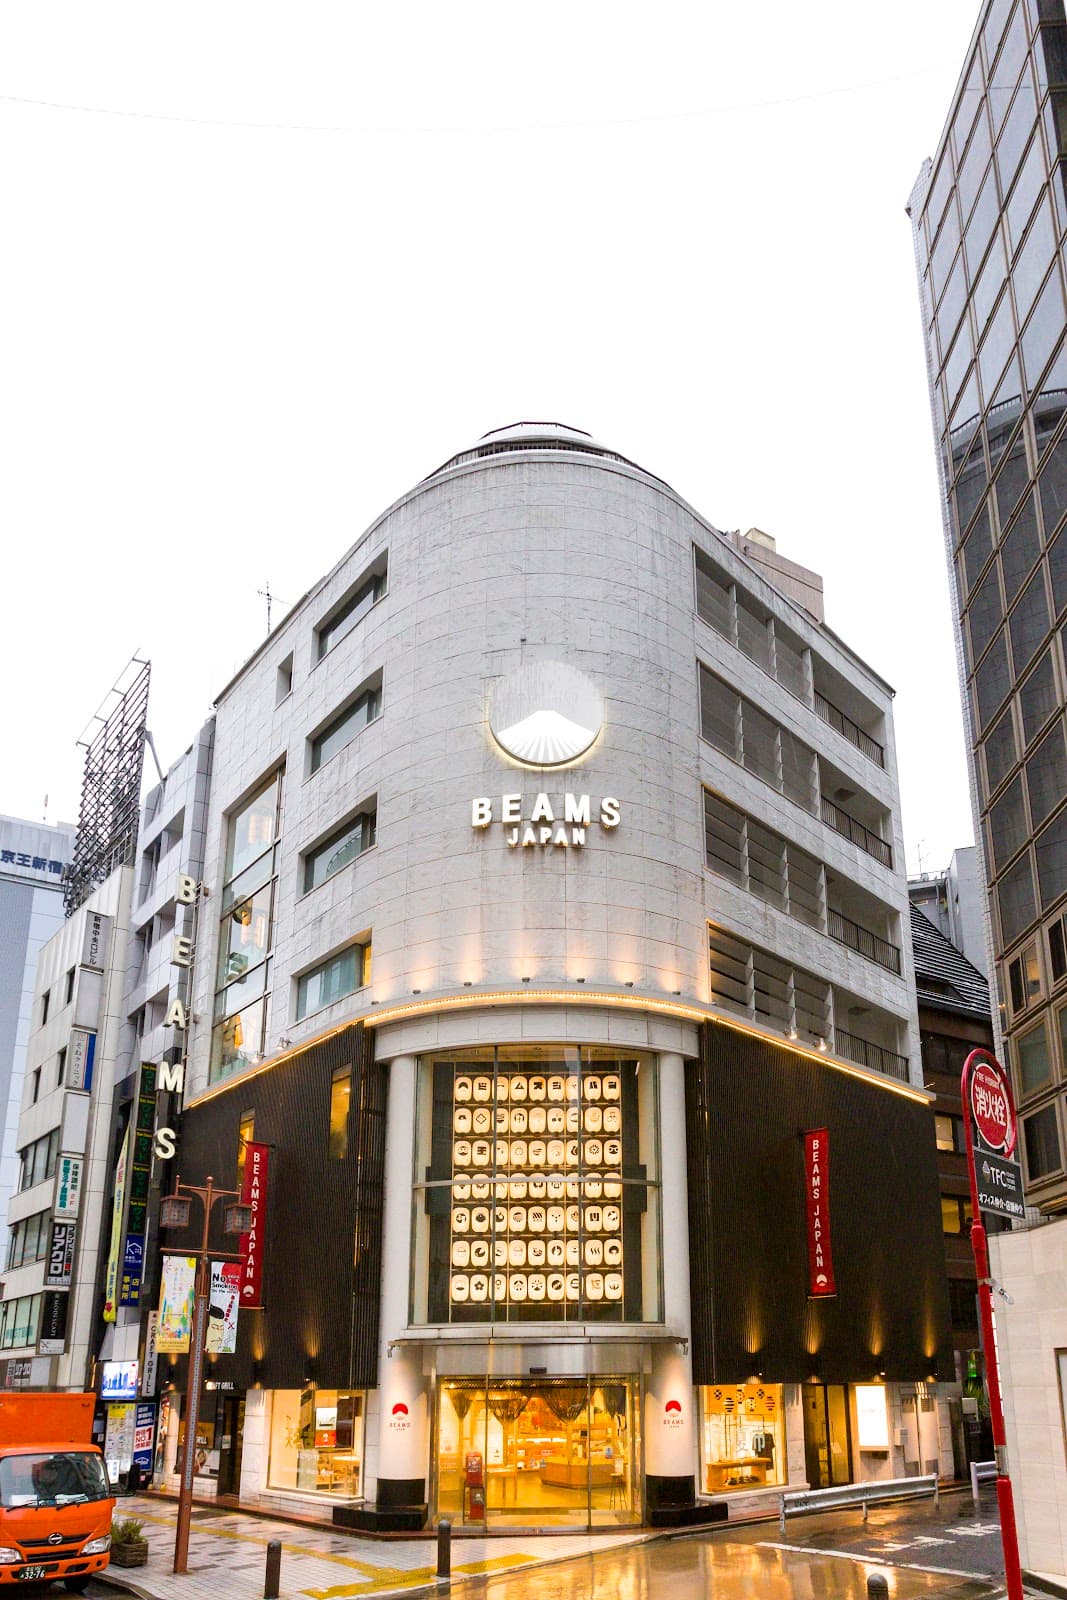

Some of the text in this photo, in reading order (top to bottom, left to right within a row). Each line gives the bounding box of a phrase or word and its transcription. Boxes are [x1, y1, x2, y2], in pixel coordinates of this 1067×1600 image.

[471, 793, 621, 828] BEAMS
[507, 827, 586, 847] JAPAN
[0, 850, 74, 876] 京王新宿
[153, 873, 197, 1159] BEAMS
[975, 1084, 1007, 1127] 消火栓
[989, 1166, 1007, 1188] TFC
[246, 1151, 261, 1279] BEAMS JAPAN
[812, 1139, 824, 1268] BEAMS JAPAN
[49, 1226, 66, 1275] リアクロ
[212, 1273, 226, 1283] No
[146, 1361, 154, 1394] GRILL
